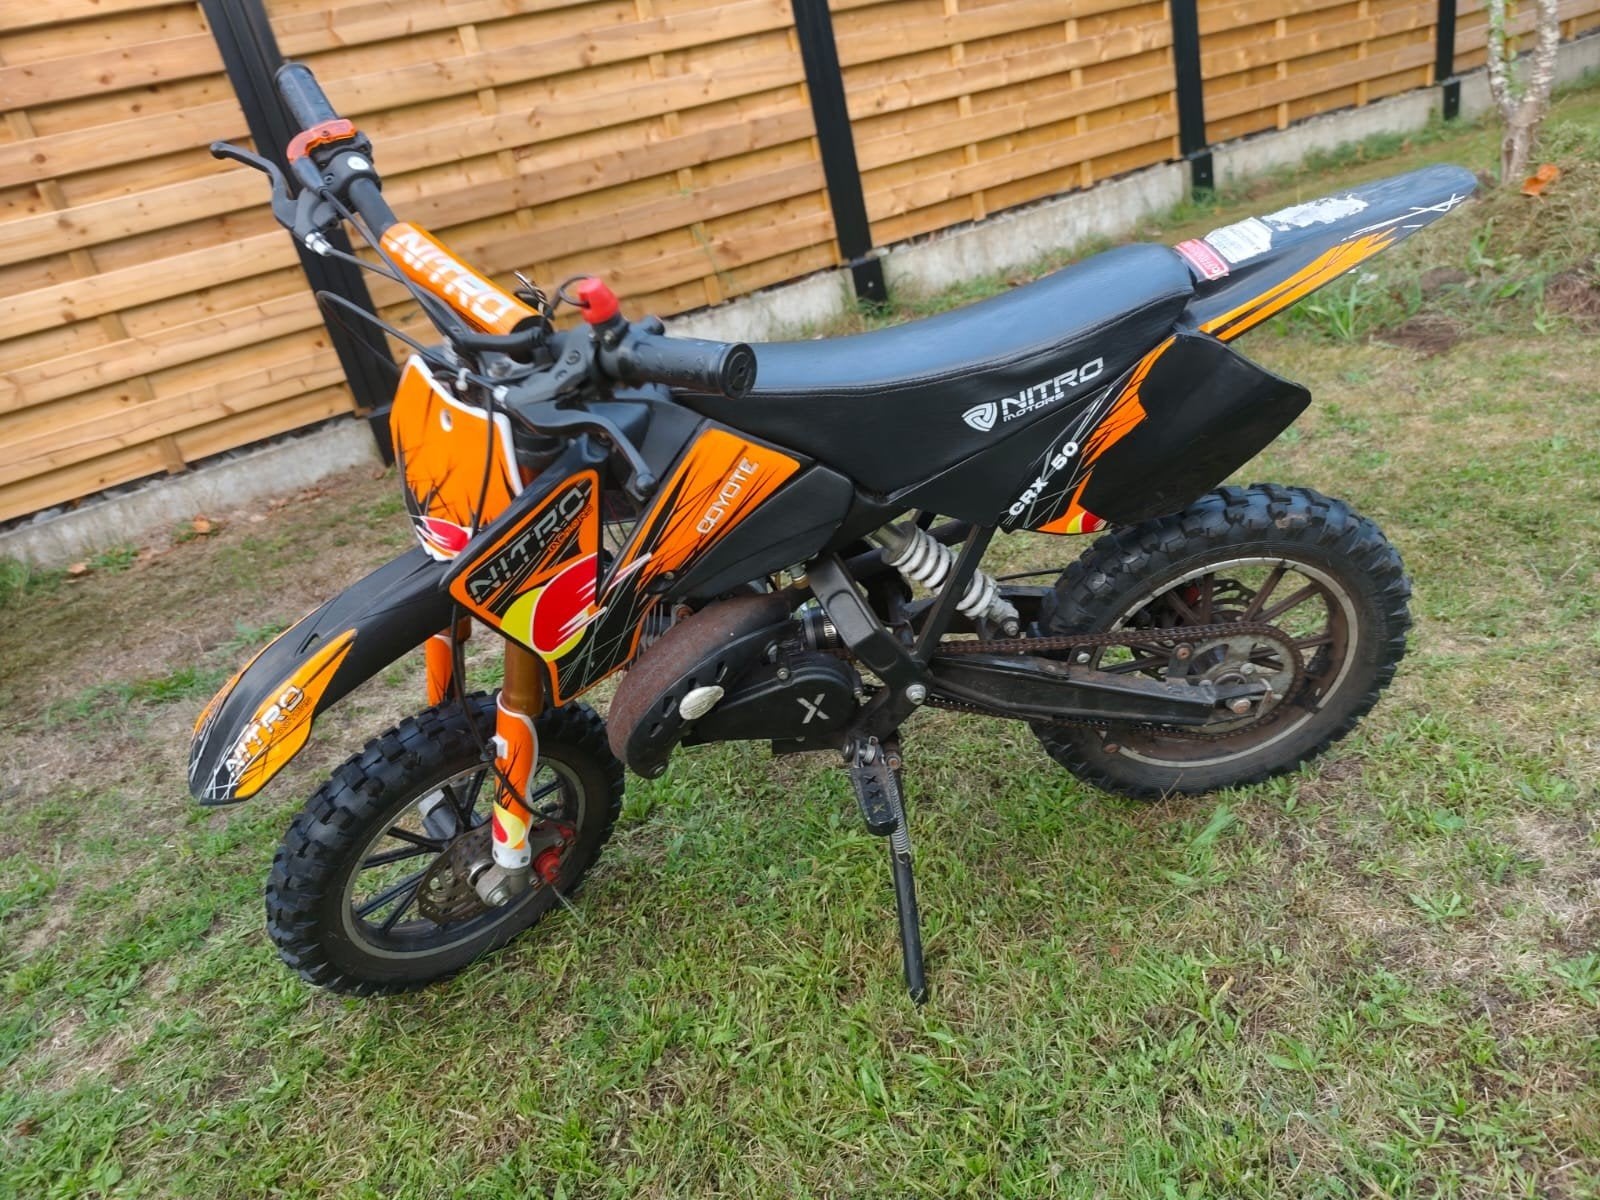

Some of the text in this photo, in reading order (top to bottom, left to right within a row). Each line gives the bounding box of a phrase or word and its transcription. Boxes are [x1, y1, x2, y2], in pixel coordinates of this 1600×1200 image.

[389, 231, 517, 323] NITRO
[1001, 356, 1104, 416] NITRO
[1003, 391, 1065, 423] MOTORS
[696, 456, 760, 535] COYOTE
[1008, 440, 1079, 516] CRX 50
[469, 487, 584, 604] NITRO
[225, 685, 304, 778] NITRO
